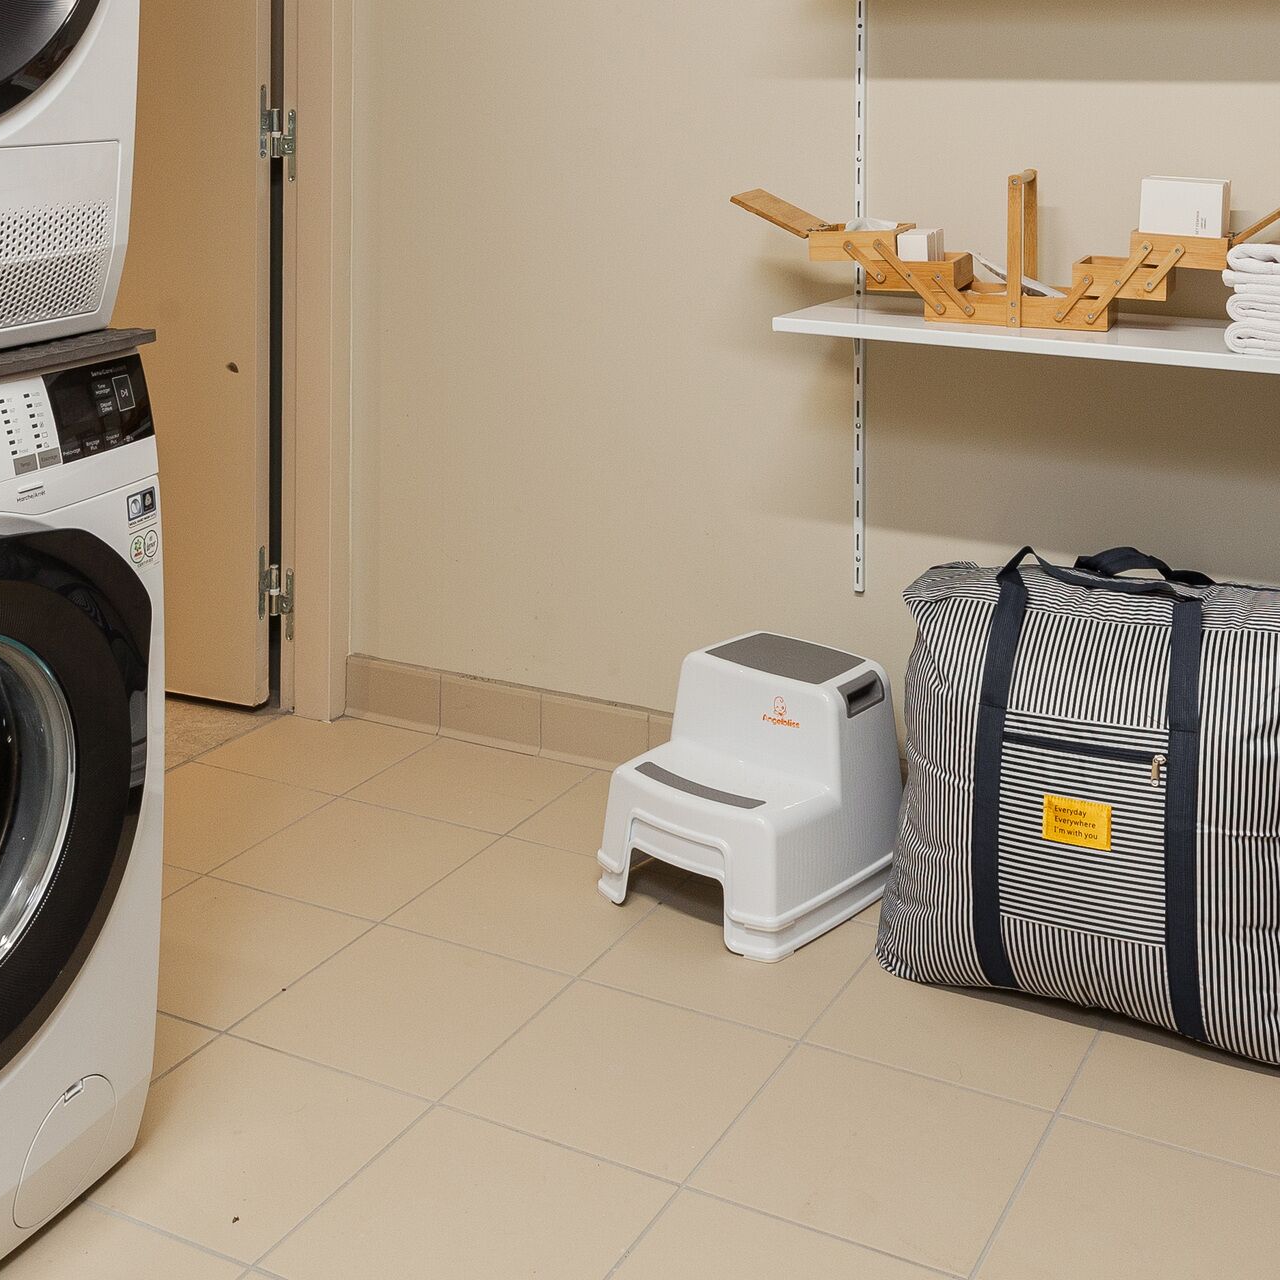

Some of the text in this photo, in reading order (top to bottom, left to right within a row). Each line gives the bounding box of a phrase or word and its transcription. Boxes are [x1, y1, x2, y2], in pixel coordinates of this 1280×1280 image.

[1054, 805, 1087, 817] Everyday
[1054, 816, 1096, 829] Everywhere
[1053, 825, 1098, 840] I'm with you
